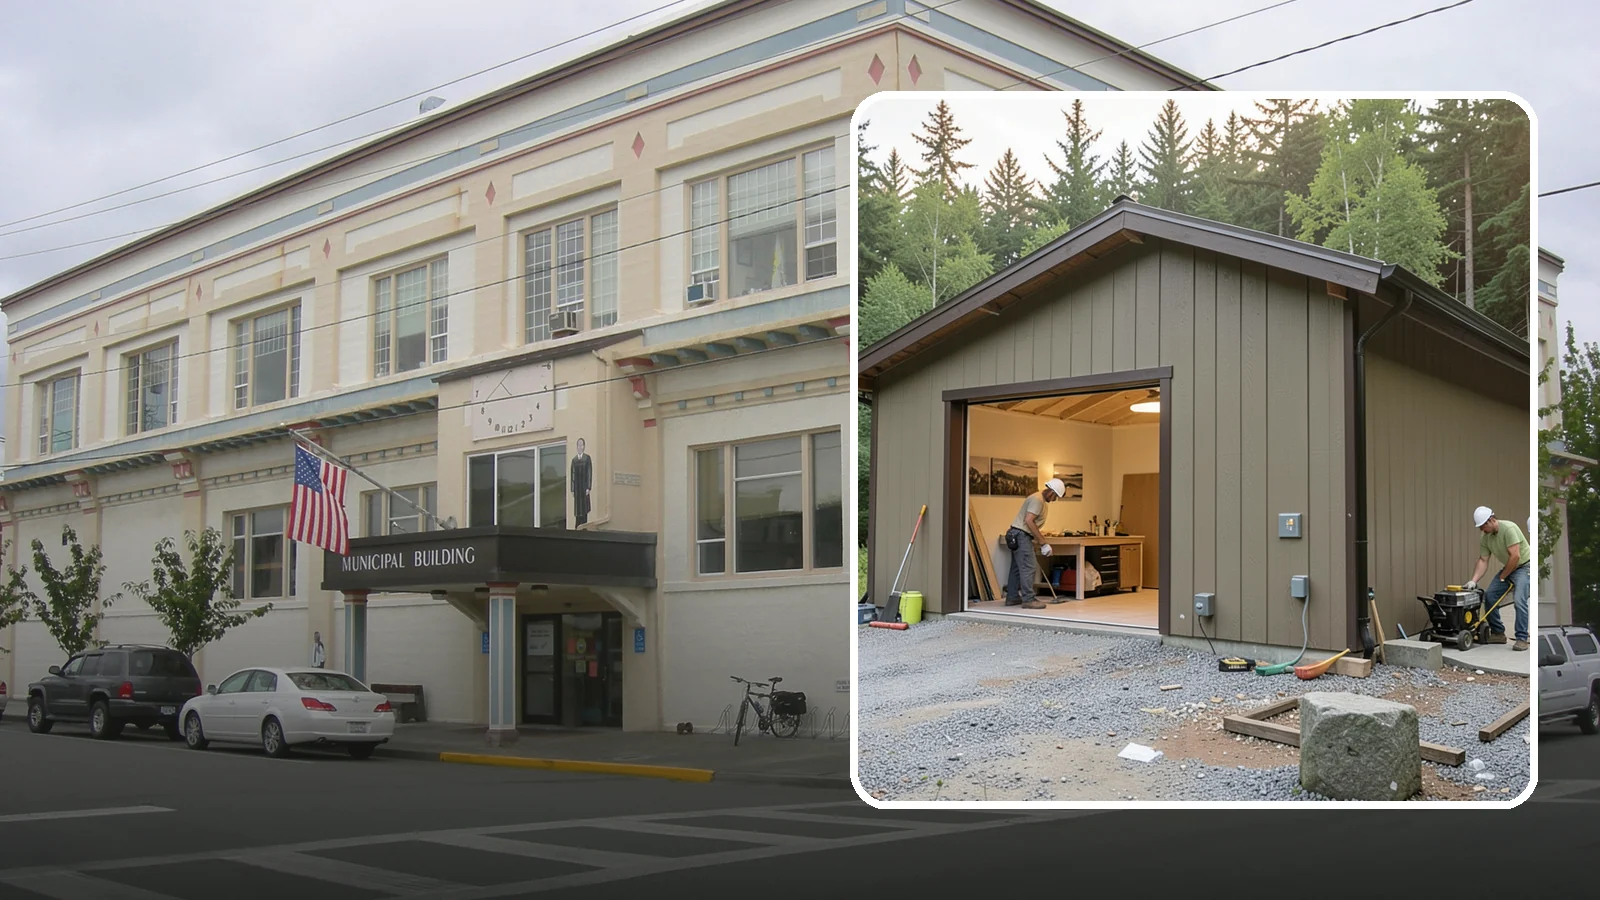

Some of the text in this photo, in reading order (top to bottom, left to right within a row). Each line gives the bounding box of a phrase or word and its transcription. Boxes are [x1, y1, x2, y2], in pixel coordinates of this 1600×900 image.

[475, 390, 479, 398] 7
[536, 402, 540, 410] 4
[480, 407, 485, 415] 8
[487, 417, 492, 425] 9
[528, 414, 533, 422] 3
[520, 420, 525, 428] 2
[342, 546, 475, 572] MUNICIPAL BUILDING
